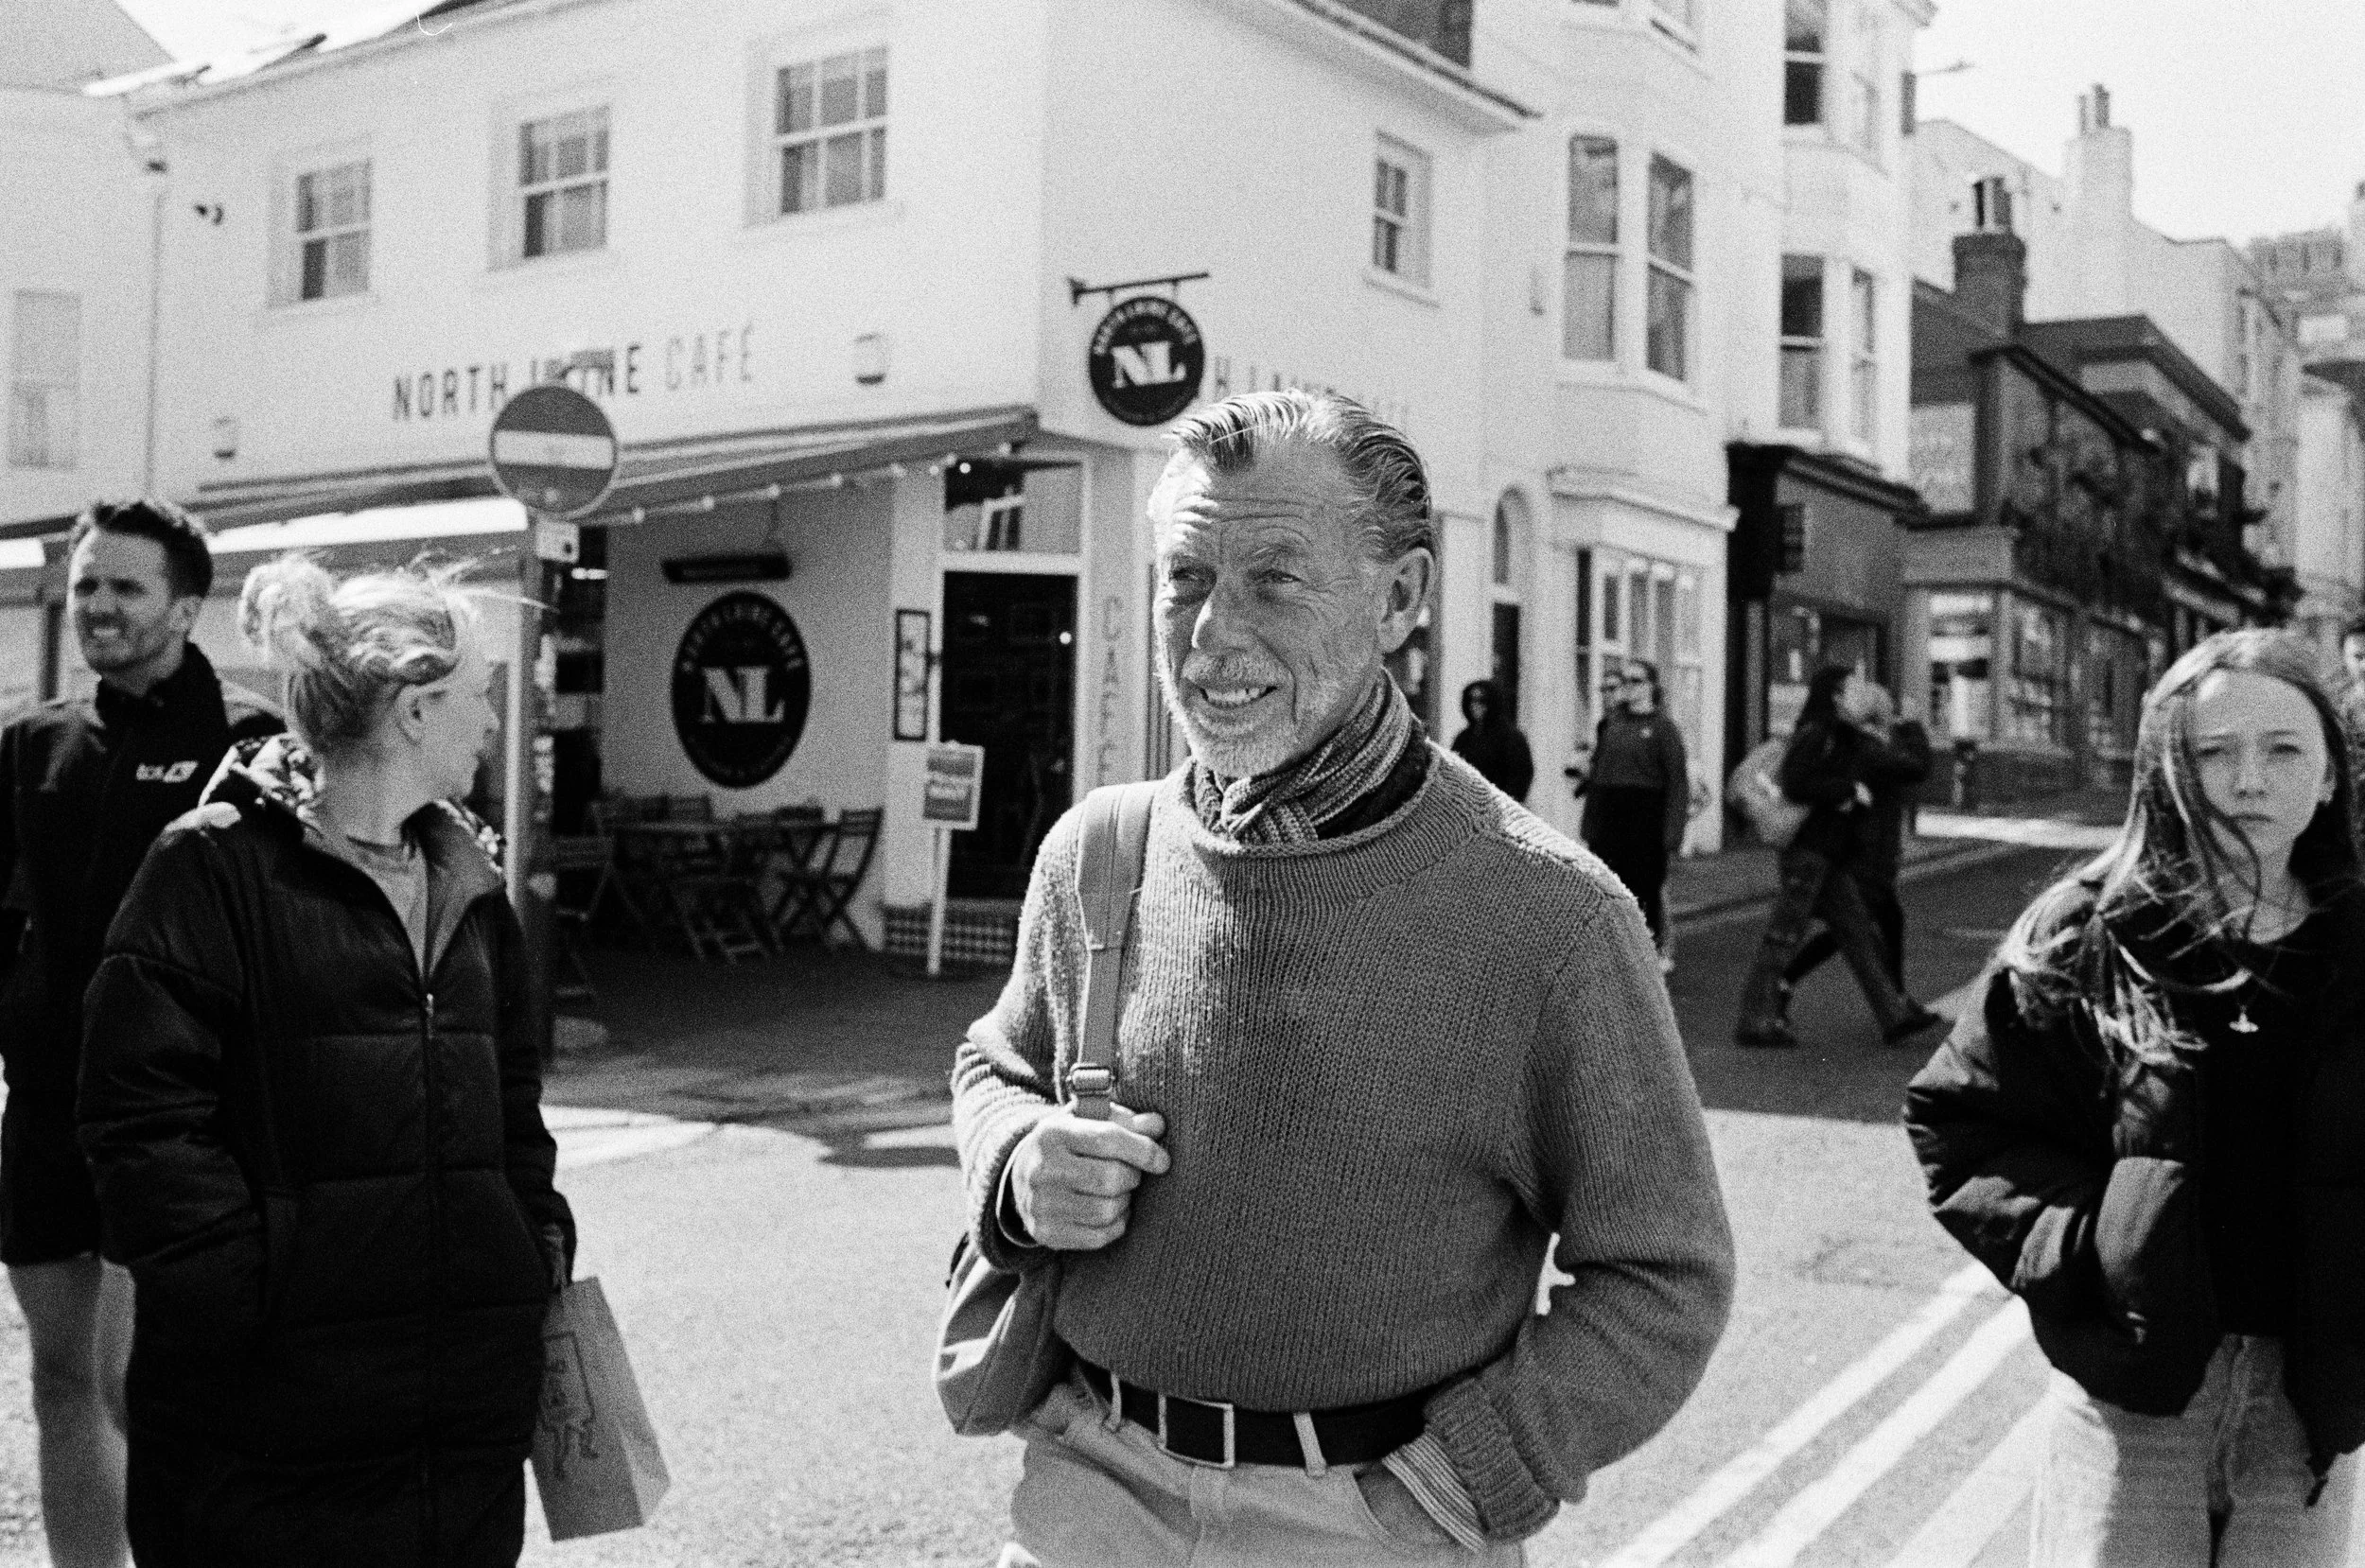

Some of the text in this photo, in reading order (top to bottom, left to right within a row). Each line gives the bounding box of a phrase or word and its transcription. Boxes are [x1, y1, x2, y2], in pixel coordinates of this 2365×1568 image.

[392, 360, 509, 422] NORTH
[1111, 340, 1186, 389] NL
[699, 665, 786, 724] NL
